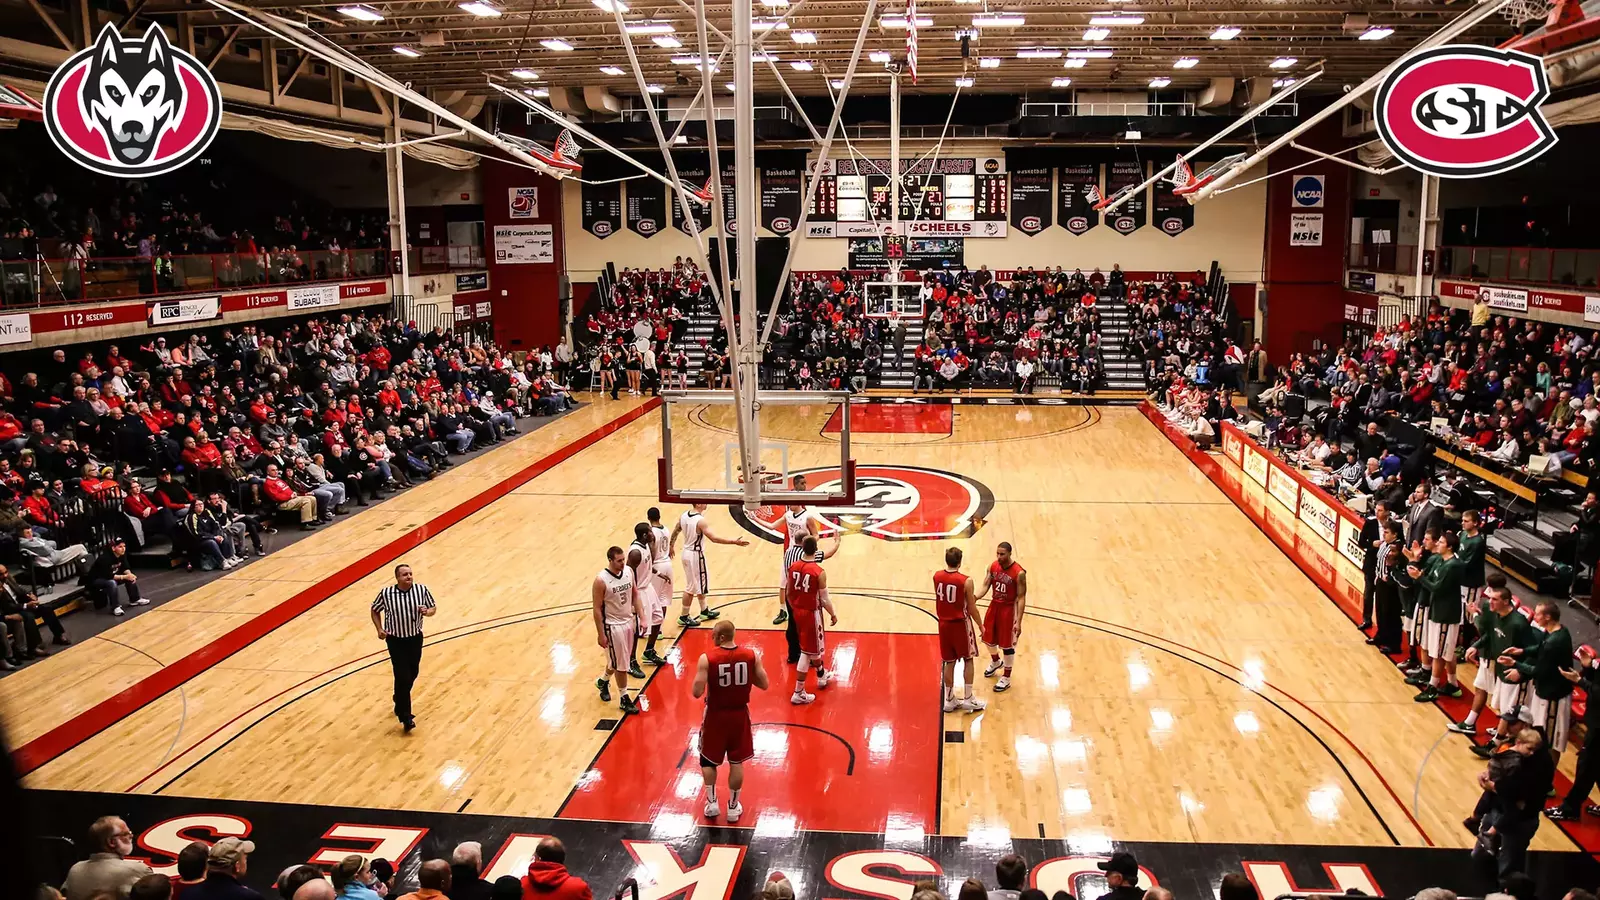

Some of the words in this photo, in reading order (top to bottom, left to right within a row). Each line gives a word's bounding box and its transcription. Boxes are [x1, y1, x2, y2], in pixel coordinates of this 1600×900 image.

[928, 191, 942, 203] 27
[1297, 190, 1322, 198] NCAA
[934, 207, 941, 215] 0
[810, 226, 832, 234] NSIC
[909, 223, 971, 231] SCHEELS
[1292, 230, 1320, 240] NSIC
[887, 244, 903, 257] 35
[346, 287, 357, 296] 114
[246, 296, 260, 307] 113
[294, 298, 320, 307] SUBARU
[1532, 294, 1543, 305] 102
[162, 307, 179, 317] RPC
[63, 313, 83, 326] 112
[86, 312, 113, 322] RESERVED
[792, 571, 810, 593] 24
[995, 581, 1006, 593] 20
[620, 592, 628, 605] 3
[936, 583, 957, 604] 40
[718, 662, 748, 687] 50
